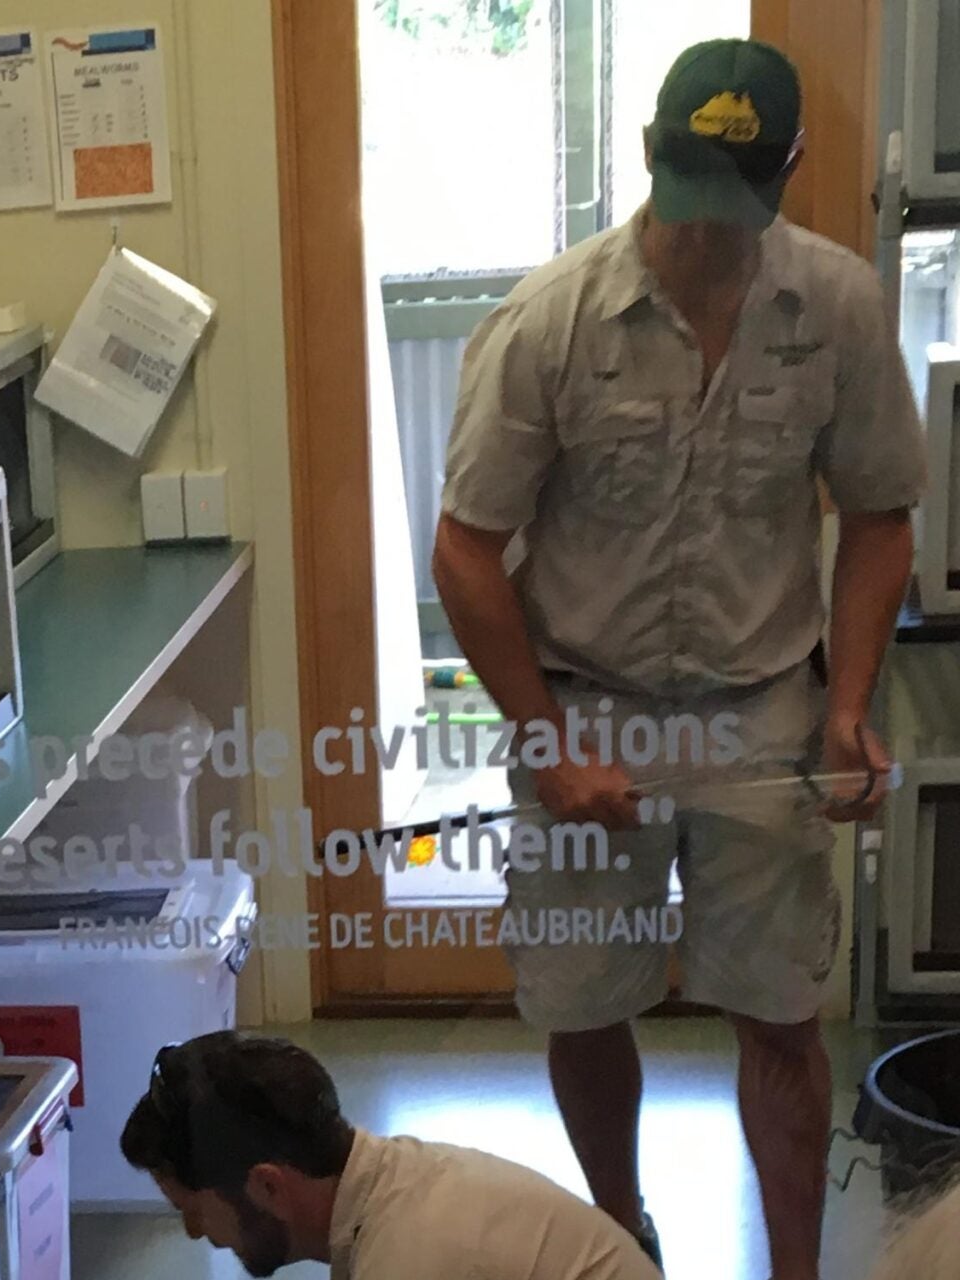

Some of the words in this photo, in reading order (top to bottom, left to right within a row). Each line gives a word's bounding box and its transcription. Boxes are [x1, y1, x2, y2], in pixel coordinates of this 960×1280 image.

[73, 62, 140, 77] MEALWORMS
[27, 706, 292, 800] precede
[311, 696, 744, 777] civilizations
[209, 805, 417, 879] follow
[438, 795, 678, 873] them."
[329, 910, 374, 950] DE
[383, 905, 684, 949] CHATEAUBRIAND
